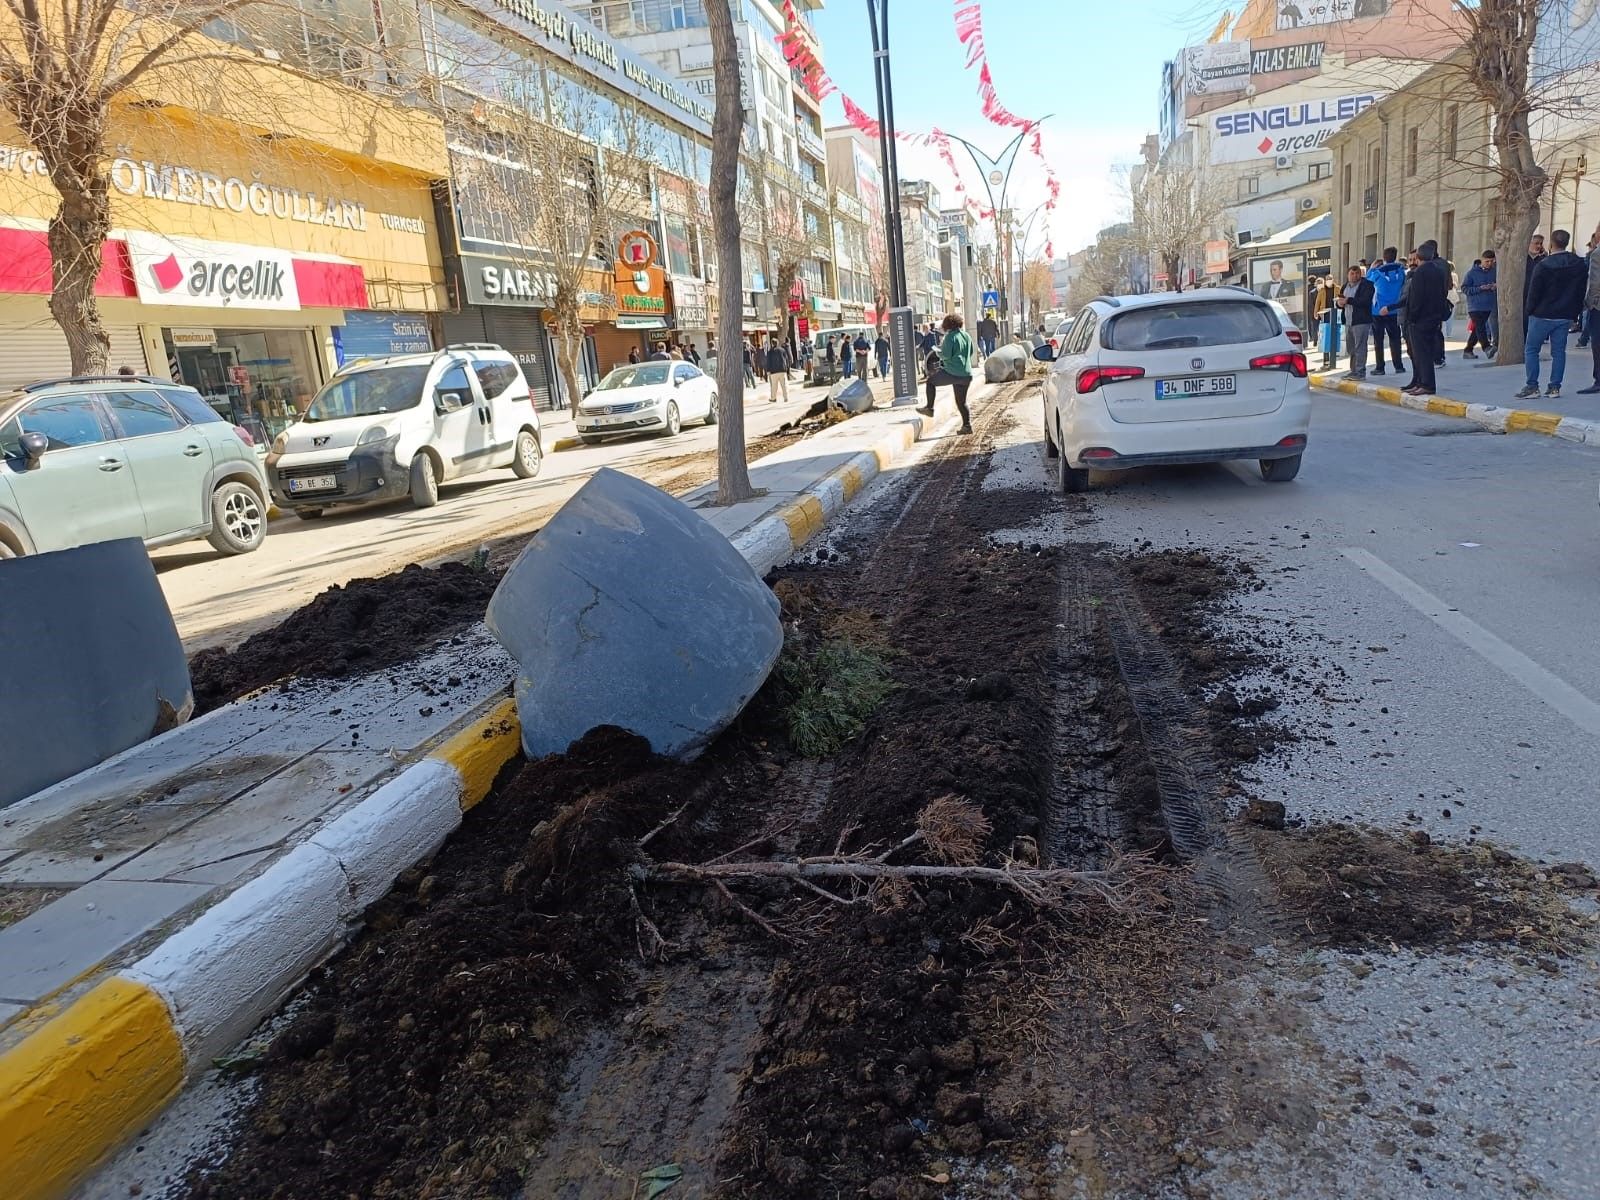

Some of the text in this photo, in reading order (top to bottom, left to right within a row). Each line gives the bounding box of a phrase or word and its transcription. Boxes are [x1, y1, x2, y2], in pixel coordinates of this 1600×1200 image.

[1308, 5, 1326, 16] ve
[1251, 47, 1285, 74] ATLAS
[1286, 43, 1324, 69] EMLAK
[1202, 69, 1223, 80] Bayan
[111, 143, 368, 232] ÖMEROĞULLARI
[188, 259, 284, 305] arçelik
[392, 322, 411, 336] Sizin
[390, 340, 429, 354] her zaman
[514, 353, 537, 365] ARAR
[1163, 381, 1178, 394] 34
[1184, 379, 1205, 392] DNF
